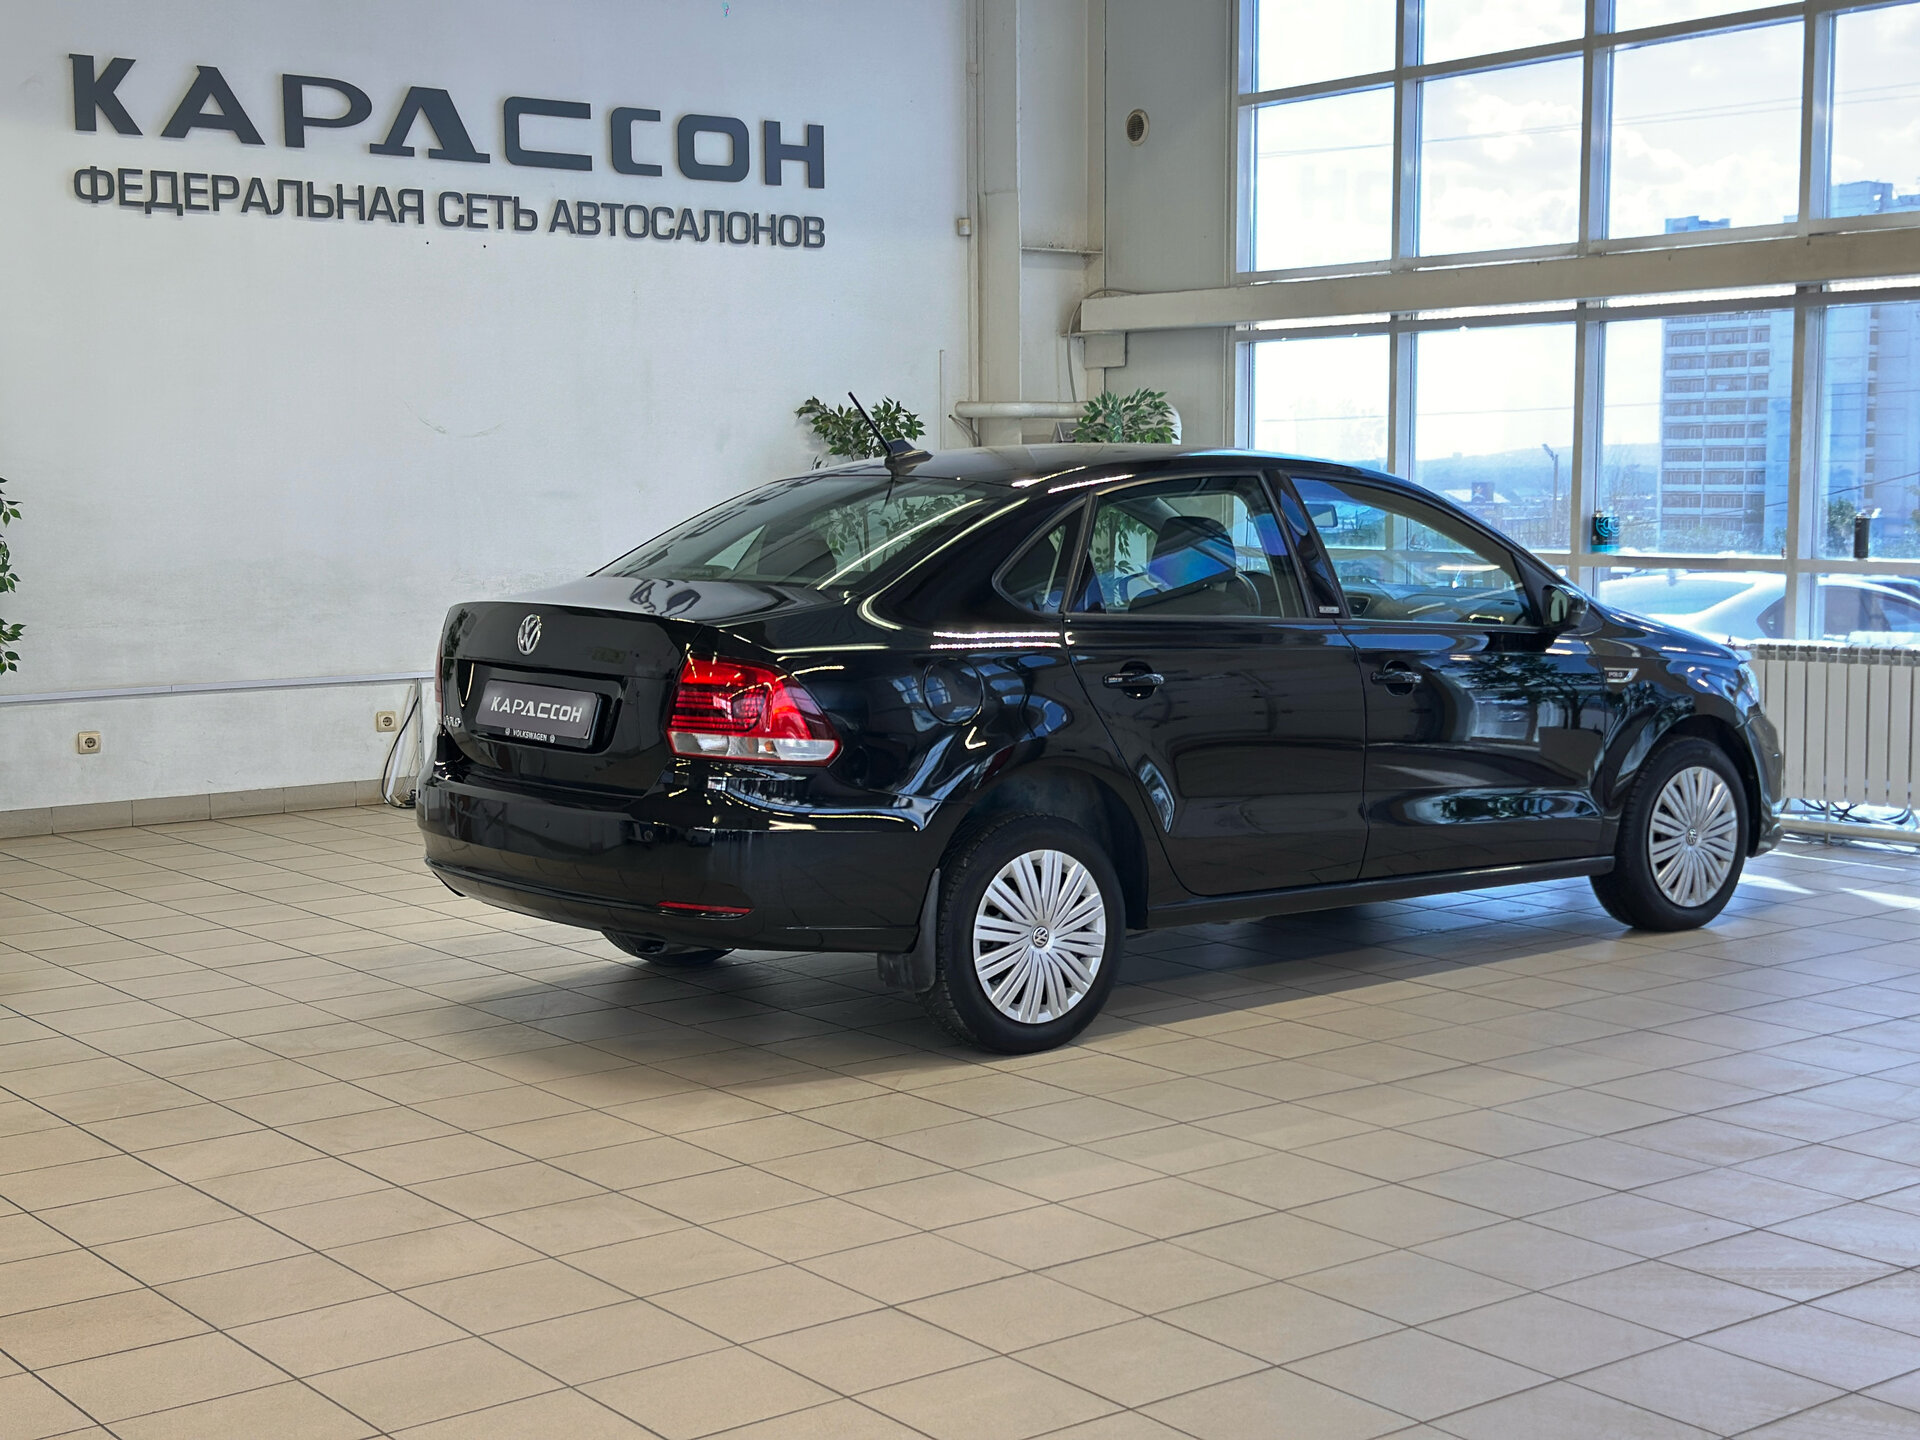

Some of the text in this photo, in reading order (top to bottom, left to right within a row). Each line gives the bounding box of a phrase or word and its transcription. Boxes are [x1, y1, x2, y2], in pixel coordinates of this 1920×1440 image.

[73, 165, 826, 249] ФЕДЕРАЛЬНАЯ СЕТЬ АВТОСАЛОНОВ
[512, 729, 548, 741] VOLKSWAGEN
